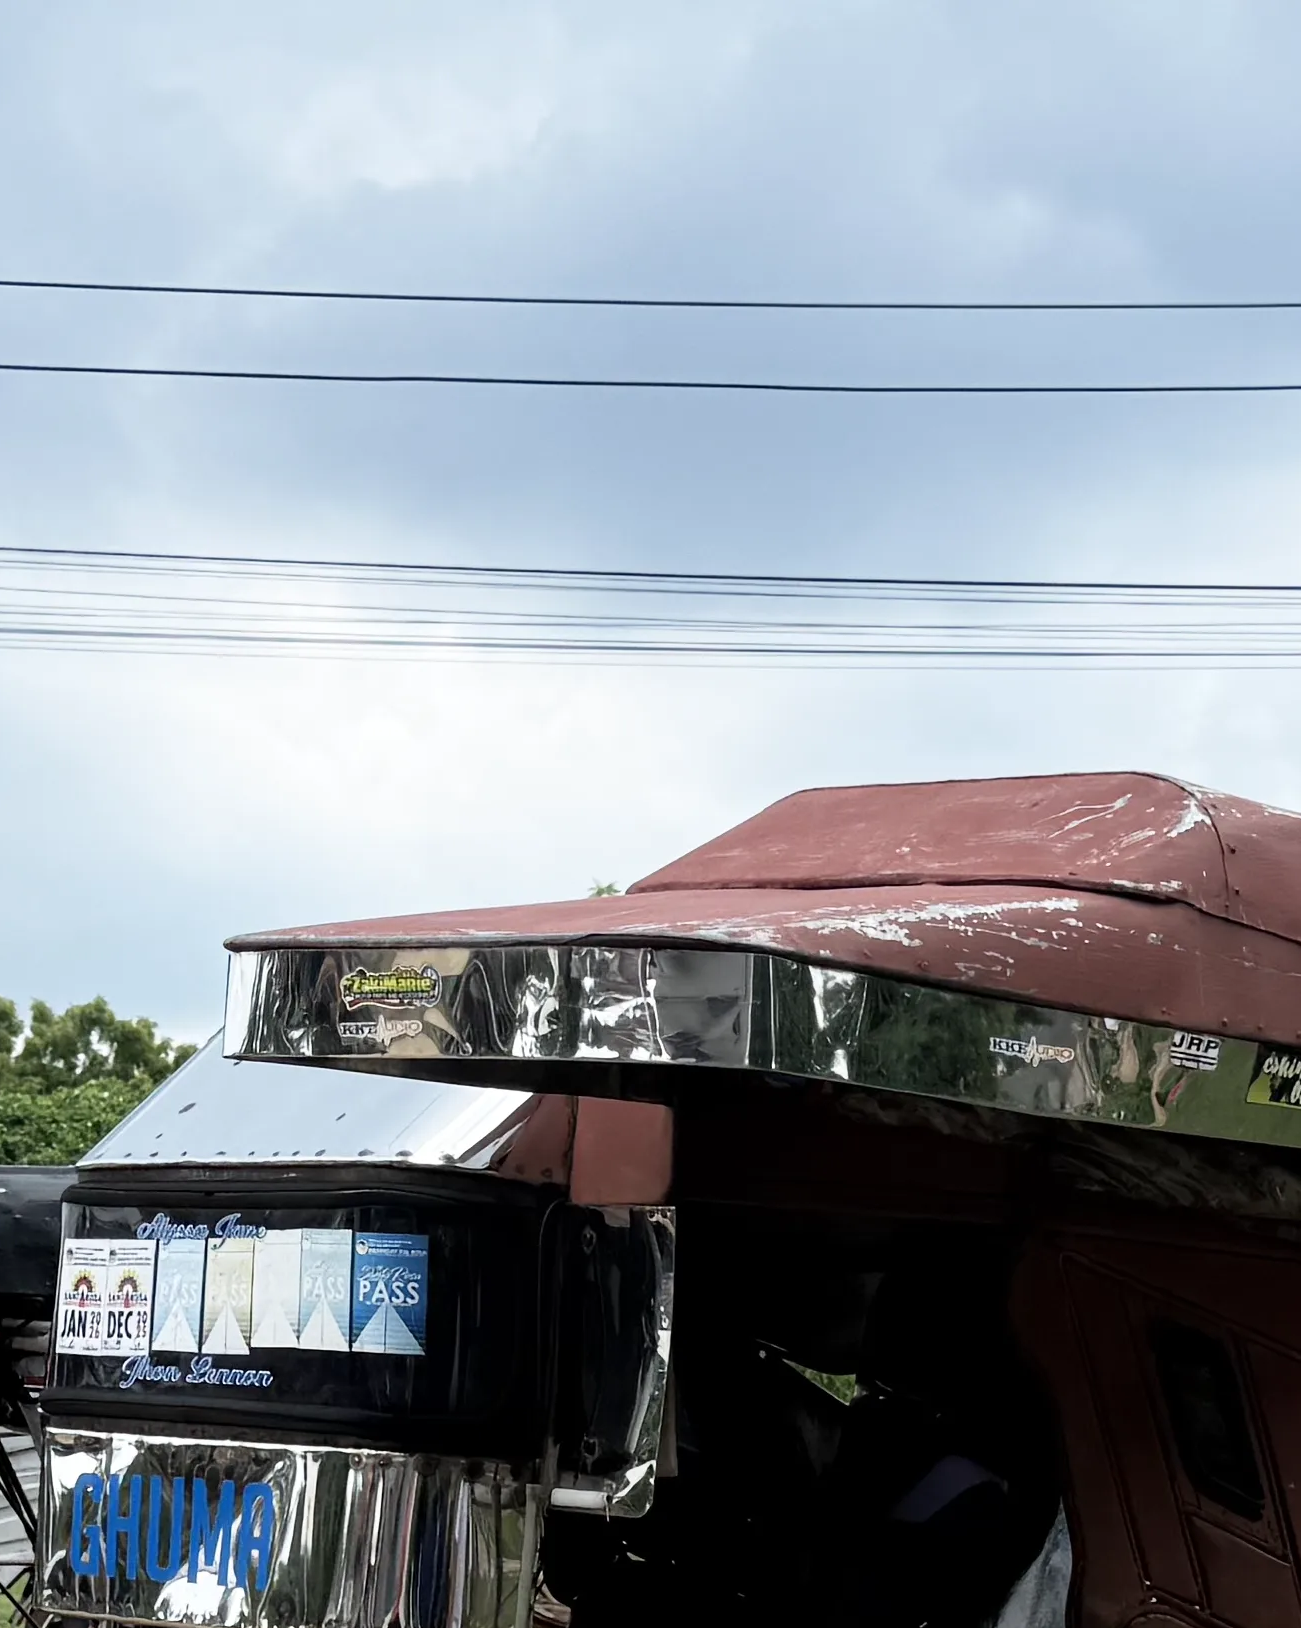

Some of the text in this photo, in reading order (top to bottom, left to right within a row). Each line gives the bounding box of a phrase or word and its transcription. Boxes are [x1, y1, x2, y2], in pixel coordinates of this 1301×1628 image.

[1172, 1033, 1220, 1053] JRP
[358, 1280, 420, 1306] PASS
[61, 1309, 88, 1338] JAN
[107, 1310, 133, 1339] DEC
[70, 1473, 275, 1593] GHUMA
